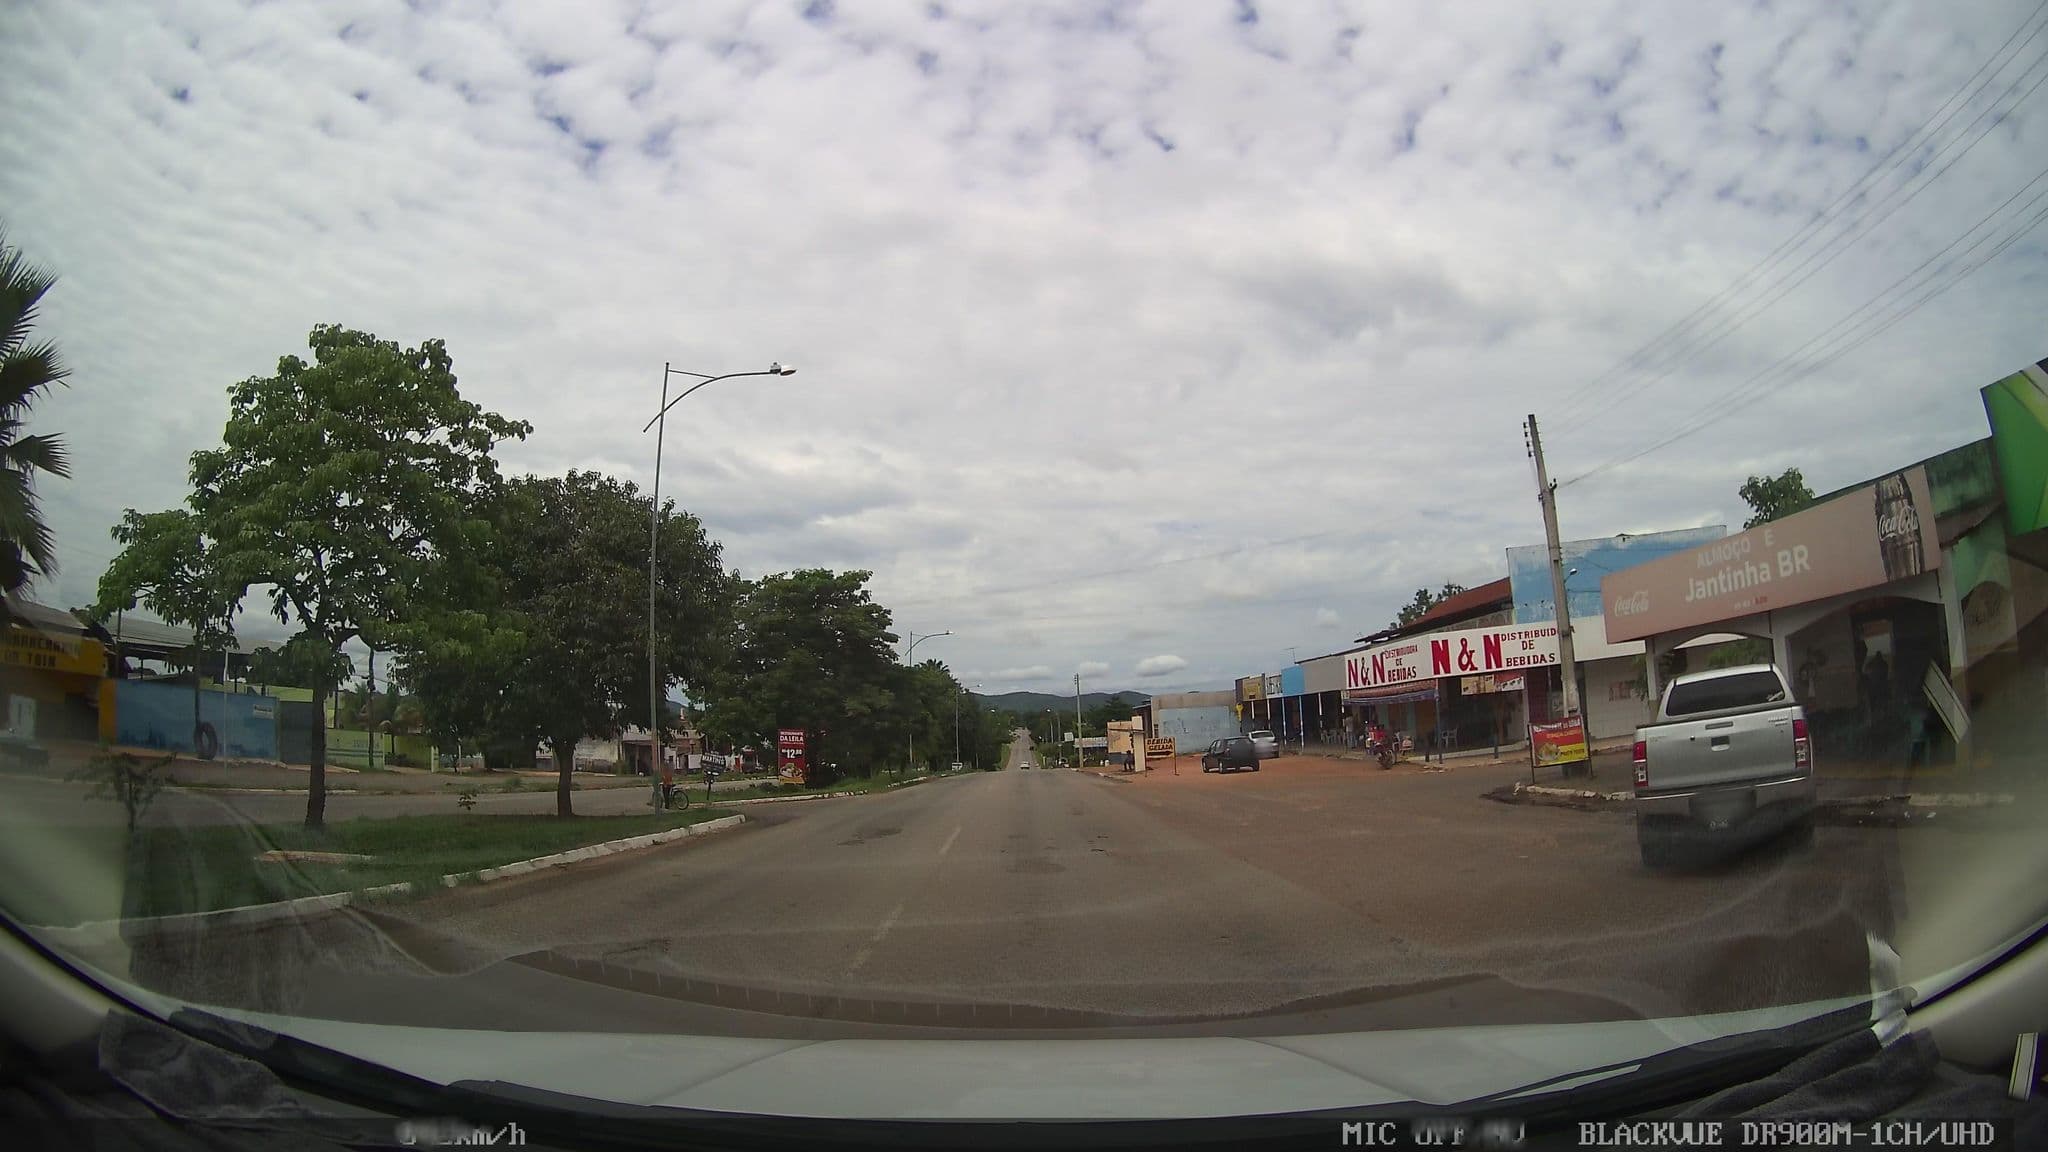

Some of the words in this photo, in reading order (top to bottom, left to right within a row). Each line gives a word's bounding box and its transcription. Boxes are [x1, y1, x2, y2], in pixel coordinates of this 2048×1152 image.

[1697, 537, 1750, 568] ALMOÇO
[1764, 529, 1776, 546] E
[1685, 561, 1771, 602] Jantinha
[1777, 545, 1811, 577] BR
[1501, 628, 1559, 642] DISTRIBUID
[1521, 640, 1535, 650] DE
[1395, 658, 1403, 666] DE
[1506, 653, 1556, 667] BEBIDAS
[1388, 666, 1417, 682] BEBIDAS
